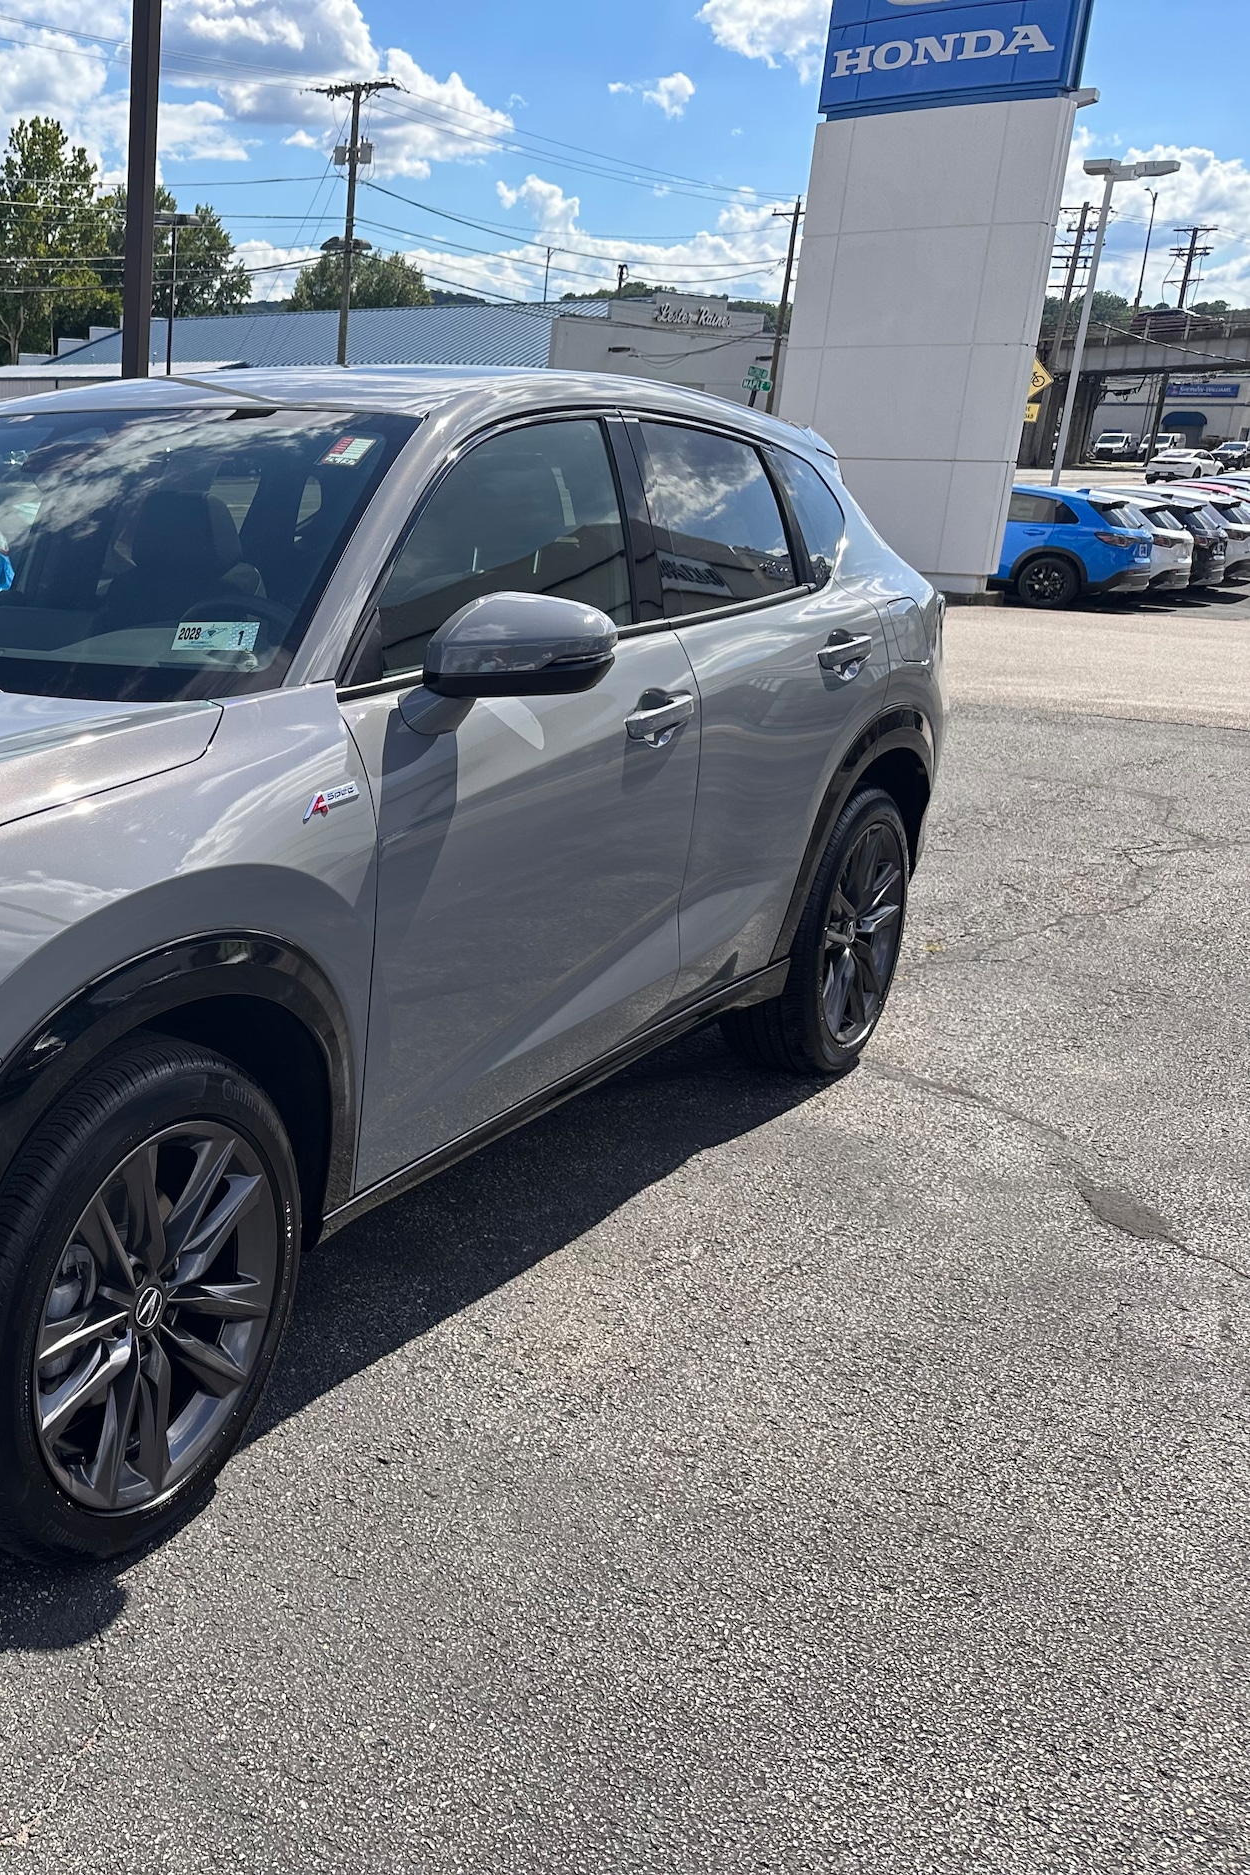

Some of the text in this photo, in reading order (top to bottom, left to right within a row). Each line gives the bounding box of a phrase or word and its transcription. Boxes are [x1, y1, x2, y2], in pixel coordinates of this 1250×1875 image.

[830, 24, 1055, 78] HONDA
[656, 302, 732, 328] Lester Raines
[742, 381, 764, 391] MAPLE
[177, 627, 245, 646] 2028 1
